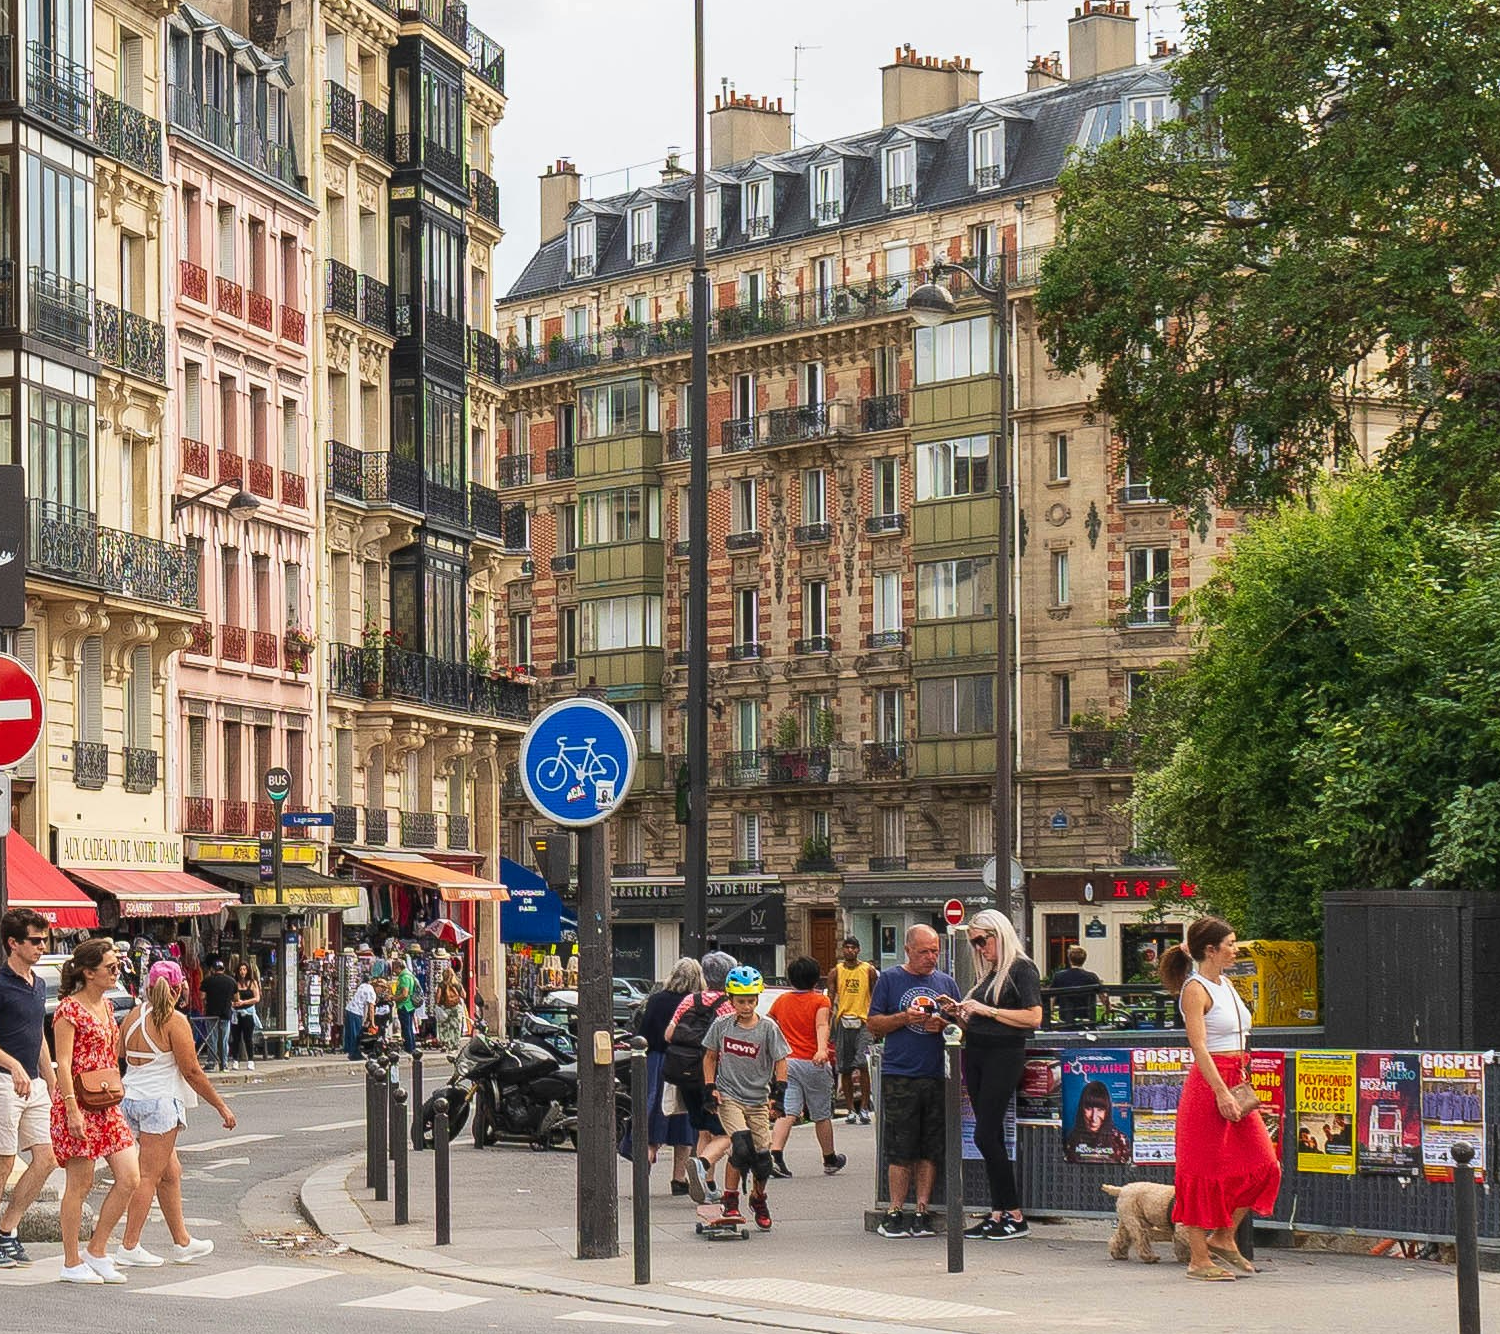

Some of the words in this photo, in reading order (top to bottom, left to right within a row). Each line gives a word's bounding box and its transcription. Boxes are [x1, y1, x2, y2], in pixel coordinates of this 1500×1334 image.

[268, 775, 288, 786] BUS
[293, 816, 323, 825] Lagrange
[64, 836, 80, 861] AUX
[83, 837, 119, 863] CADEAUX
[120, 839, 131, 863] DE
[133, 840, 158, 864] NOTRE
[159, 841, 180, 865] DAME
[724, 884, 739, 895] DE
[1379, 1059, 1408, 1072] RAVEL
[1423, 1054, 1481, 1069] GOSPEL
[1298, 1073, 1353, 1087] POLYPHONIES
[1360, 1081, 1398, 1091] MOZART
[1304, 1087, 1346, 1102] CORSES
[1298, 1101, 1352, 1113] SAROCCHI
